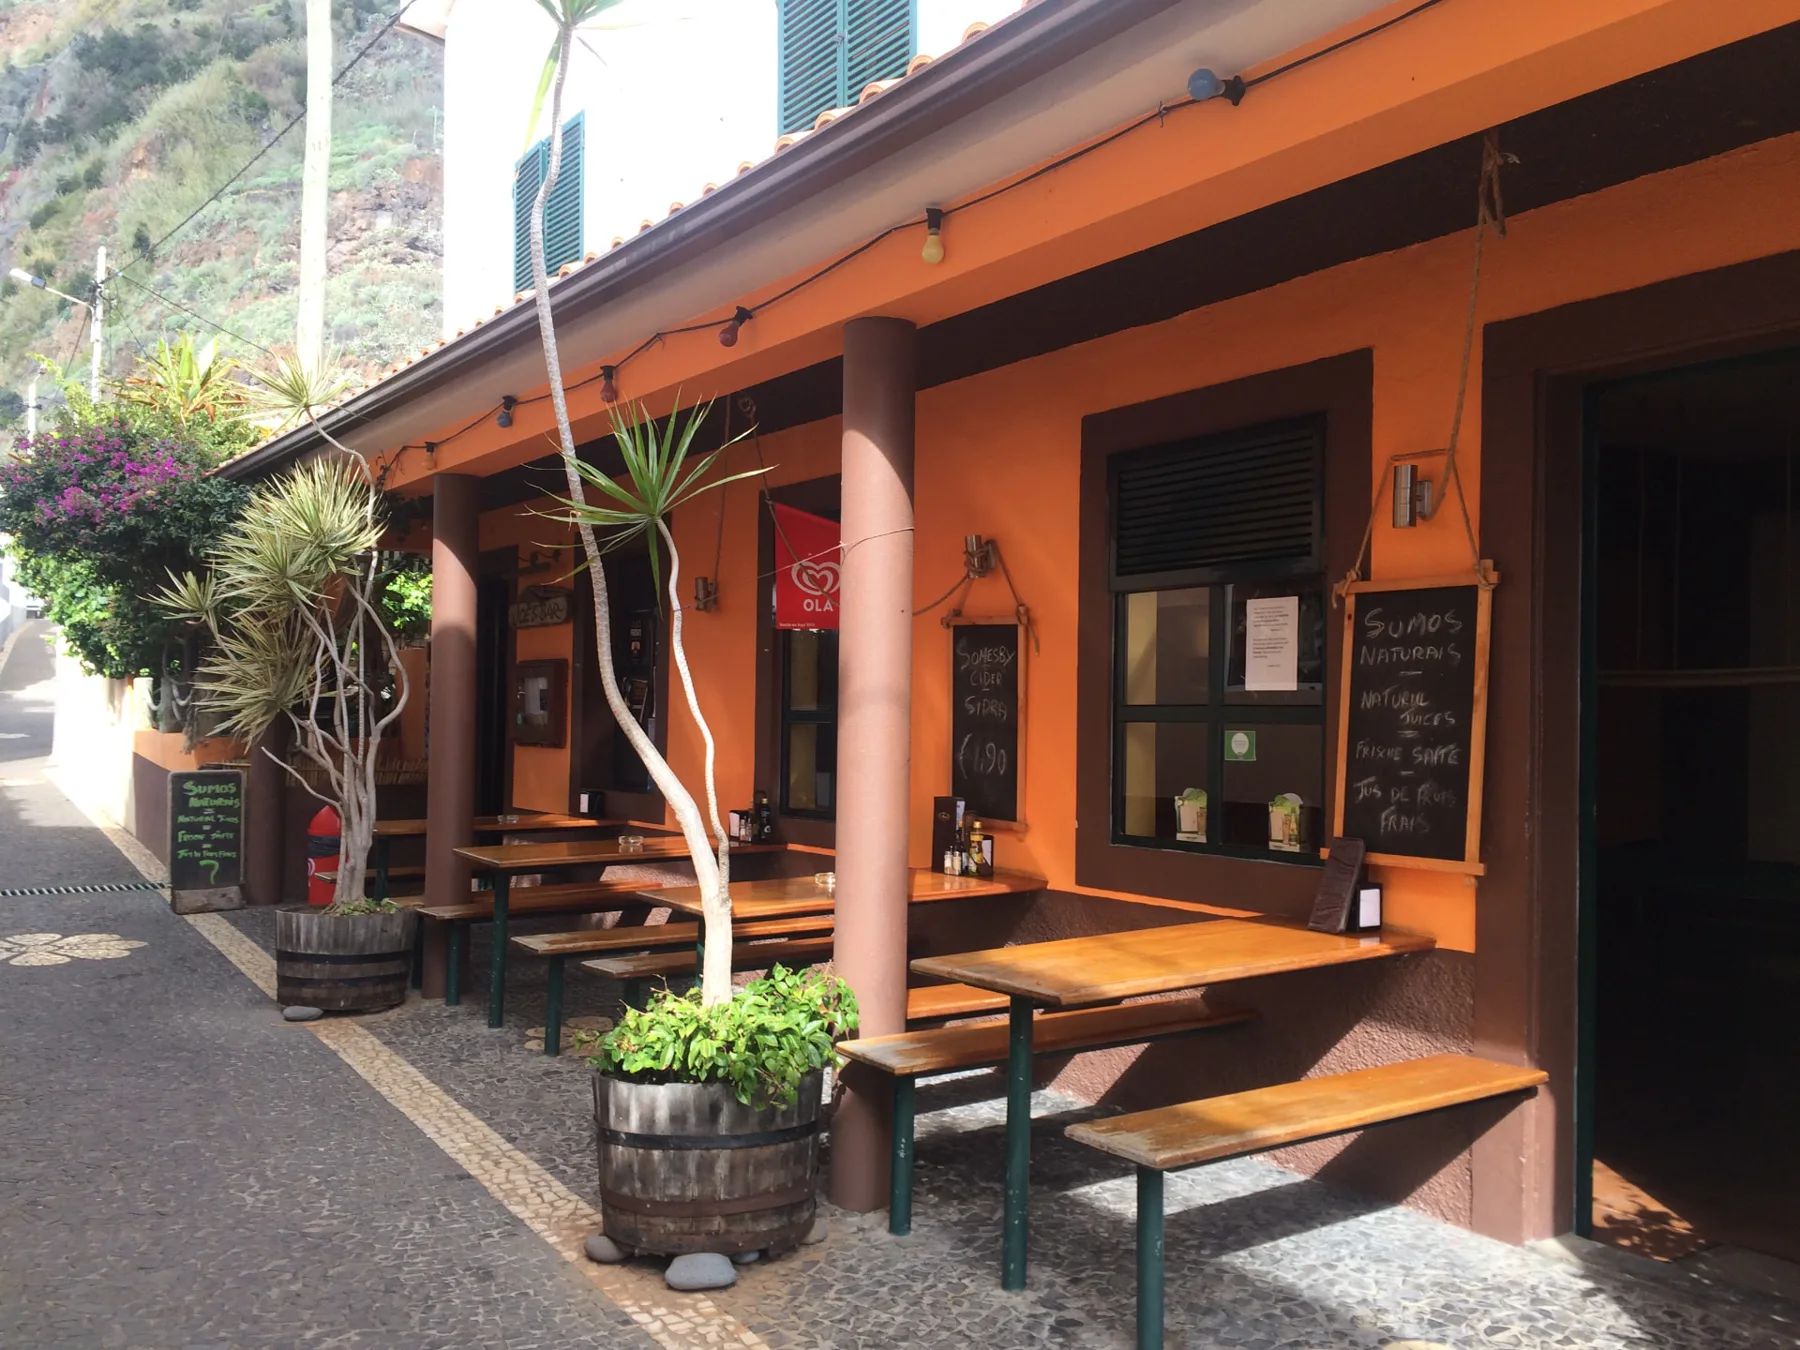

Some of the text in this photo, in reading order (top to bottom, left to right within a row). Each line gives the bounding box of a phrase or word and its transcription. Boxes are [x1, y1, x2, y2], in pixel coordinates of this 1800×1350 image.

[1364, 607, 1463, 639] SUMOS
[1360, 643, 1462, 666] NATURAIS
[970, 671, 1002, 687] CIDER
[964, 695, 1007, 721] SIDRA
[1400, 707, 1456, 726] JUICES
[1352, 776, 1381, 804] JUS
[1391, 786, 1409, 803] DE
[1380, 805, 1430, 835] FRAIS
